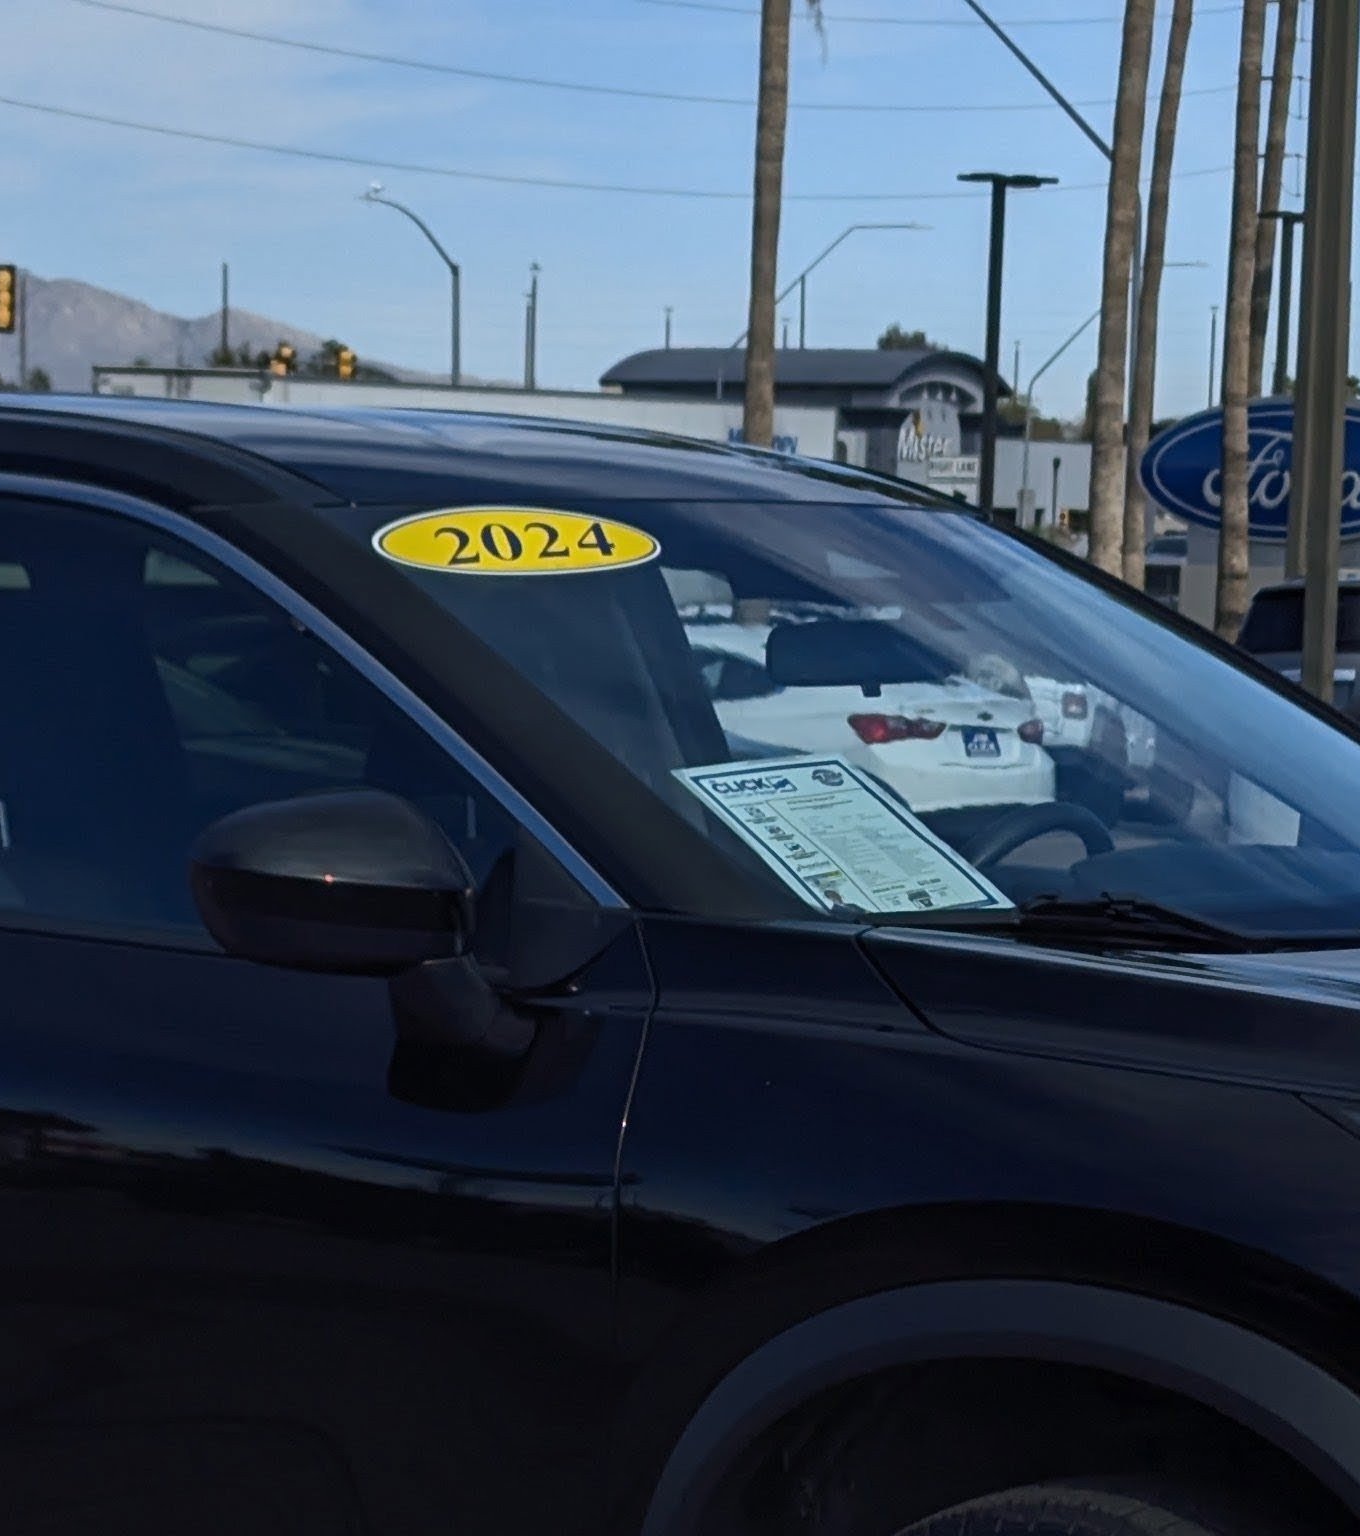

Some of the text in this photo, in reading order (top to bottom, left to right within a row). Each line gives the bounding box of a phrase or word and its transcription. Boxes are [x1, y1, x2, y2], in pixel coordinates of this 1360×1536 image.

[897, 427, 949, 462] Mister
[434, 522, 615, 566] 2024
[711, 777, 770, 794] CLICK
